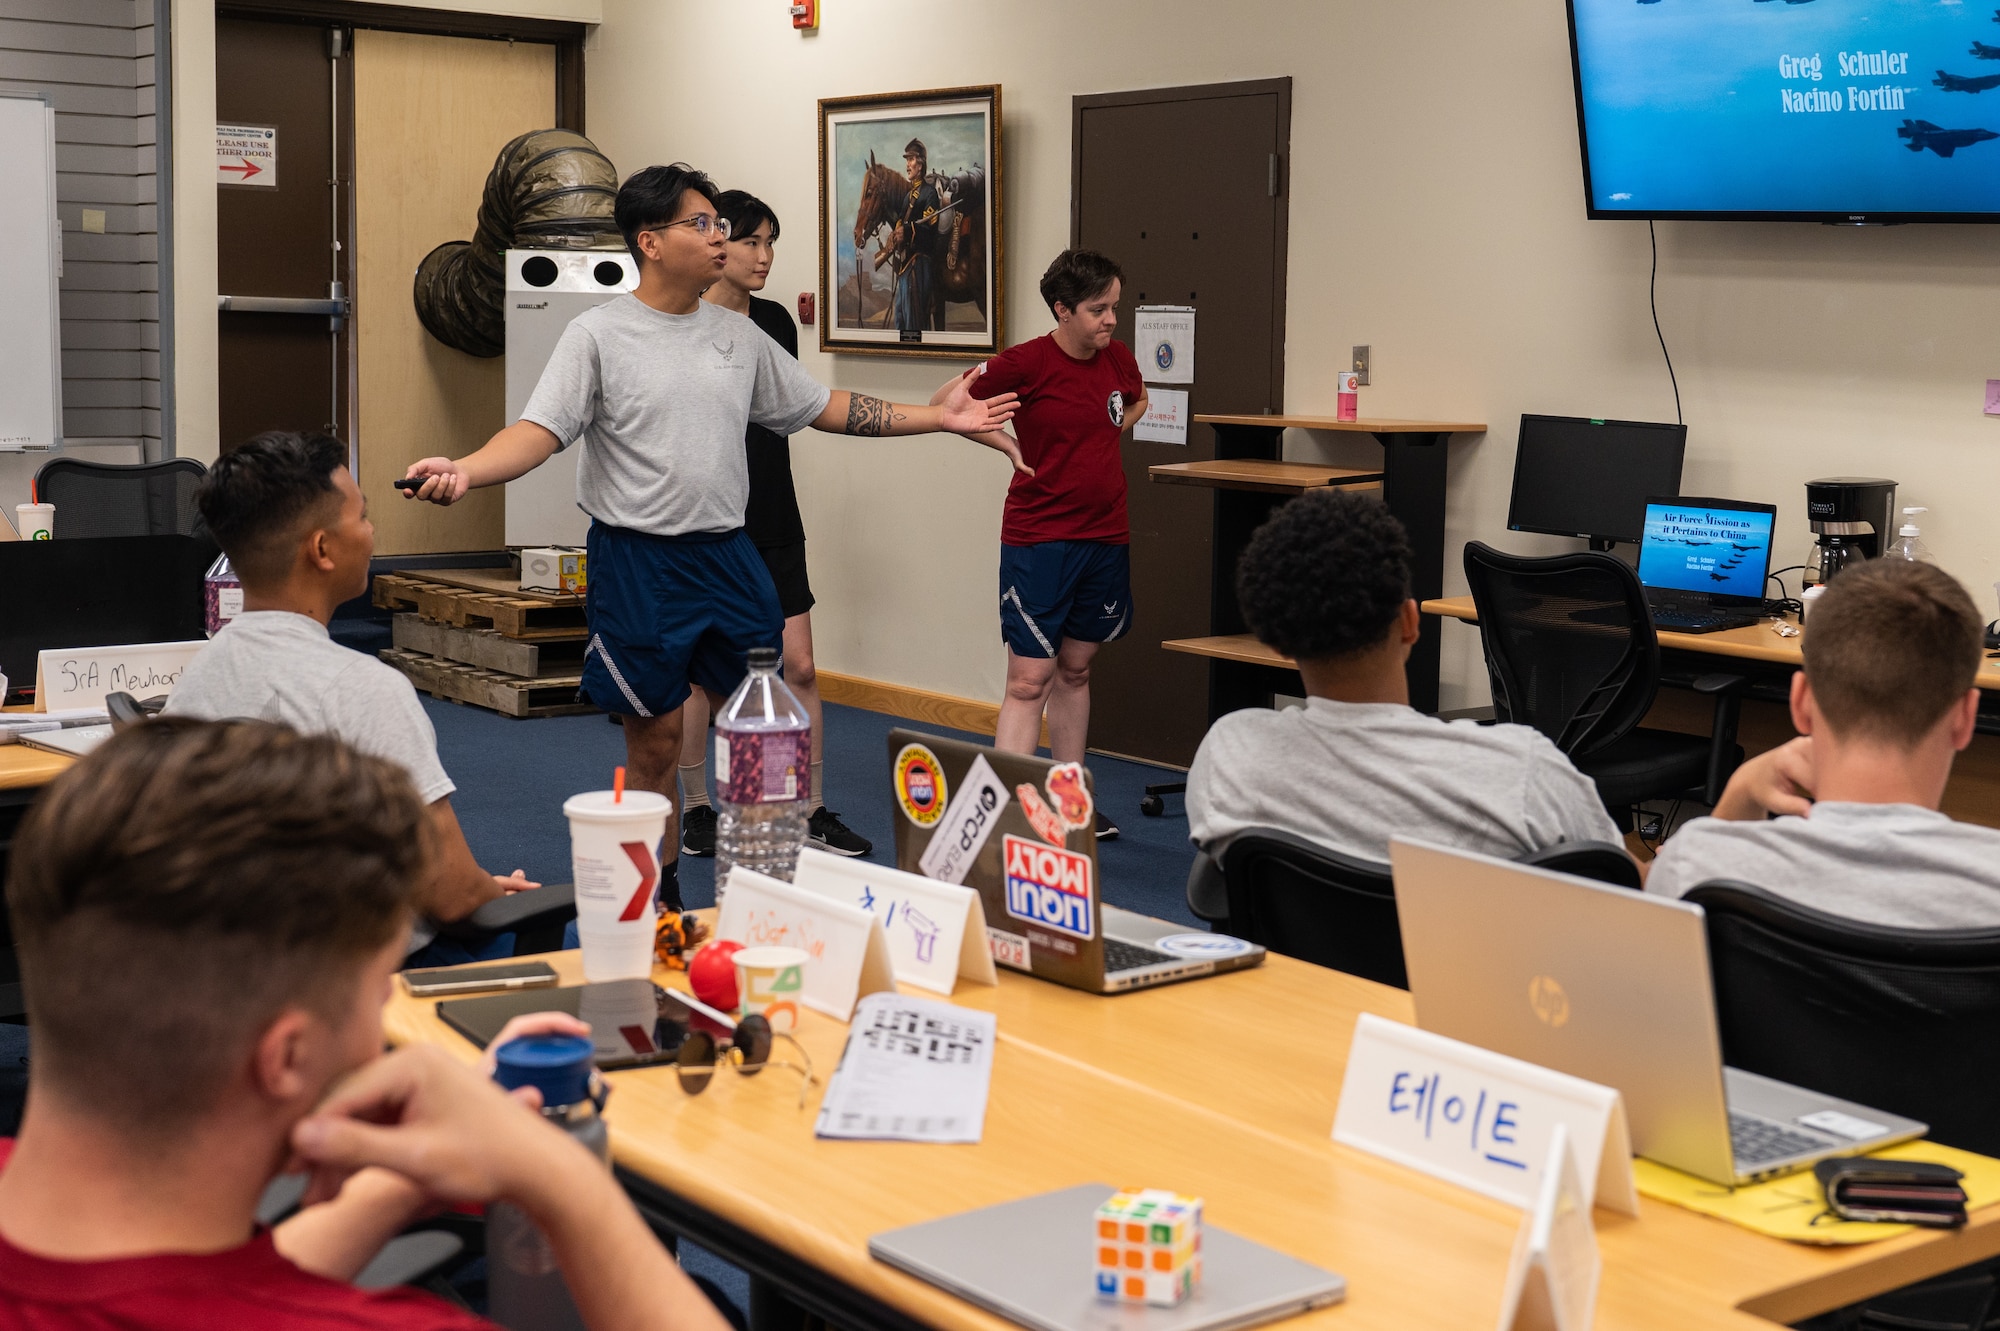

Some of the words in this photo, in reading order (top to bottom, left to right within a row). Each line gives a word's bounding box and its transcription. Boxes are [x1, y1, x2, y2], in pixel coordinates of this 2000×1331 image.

[1779, 53, 1823, 81] Greg
[1838, 50, 1909, 77] Schuler
[1781, 87, 1843, 113] Nacino
[1847, 85, 1906, 111] Fortin
[216, 139, 248, 148] LEASE
[250, 141, 269, 149] USE
[216, 148, 242, 156] THER
[245, 150, 272, 158] DOOR
[1141, 322, 1152, 330] ALS
[1152, 322, 1169, 330] STAFF
[1169, 322, 1189, 330] OFFICE
[1663, 513, 1677, 522] Air
[1679, 514, 1703, 524] Force
[1705, 516, 1739, 527] Mission
[1663, 525, 1669, 534] it
[1672, 526, 1708, 537] Pertains
[1720, 529, 1747, 540] China
[61, 660, 99, 692] SrA
[961, 803, 986, 851] FCP
[1008, 843, 1086, 893] MOLY
[1010, 878, 1088, 932] LIQUI
[1389, 1072, 1527, 1170] 테이트
